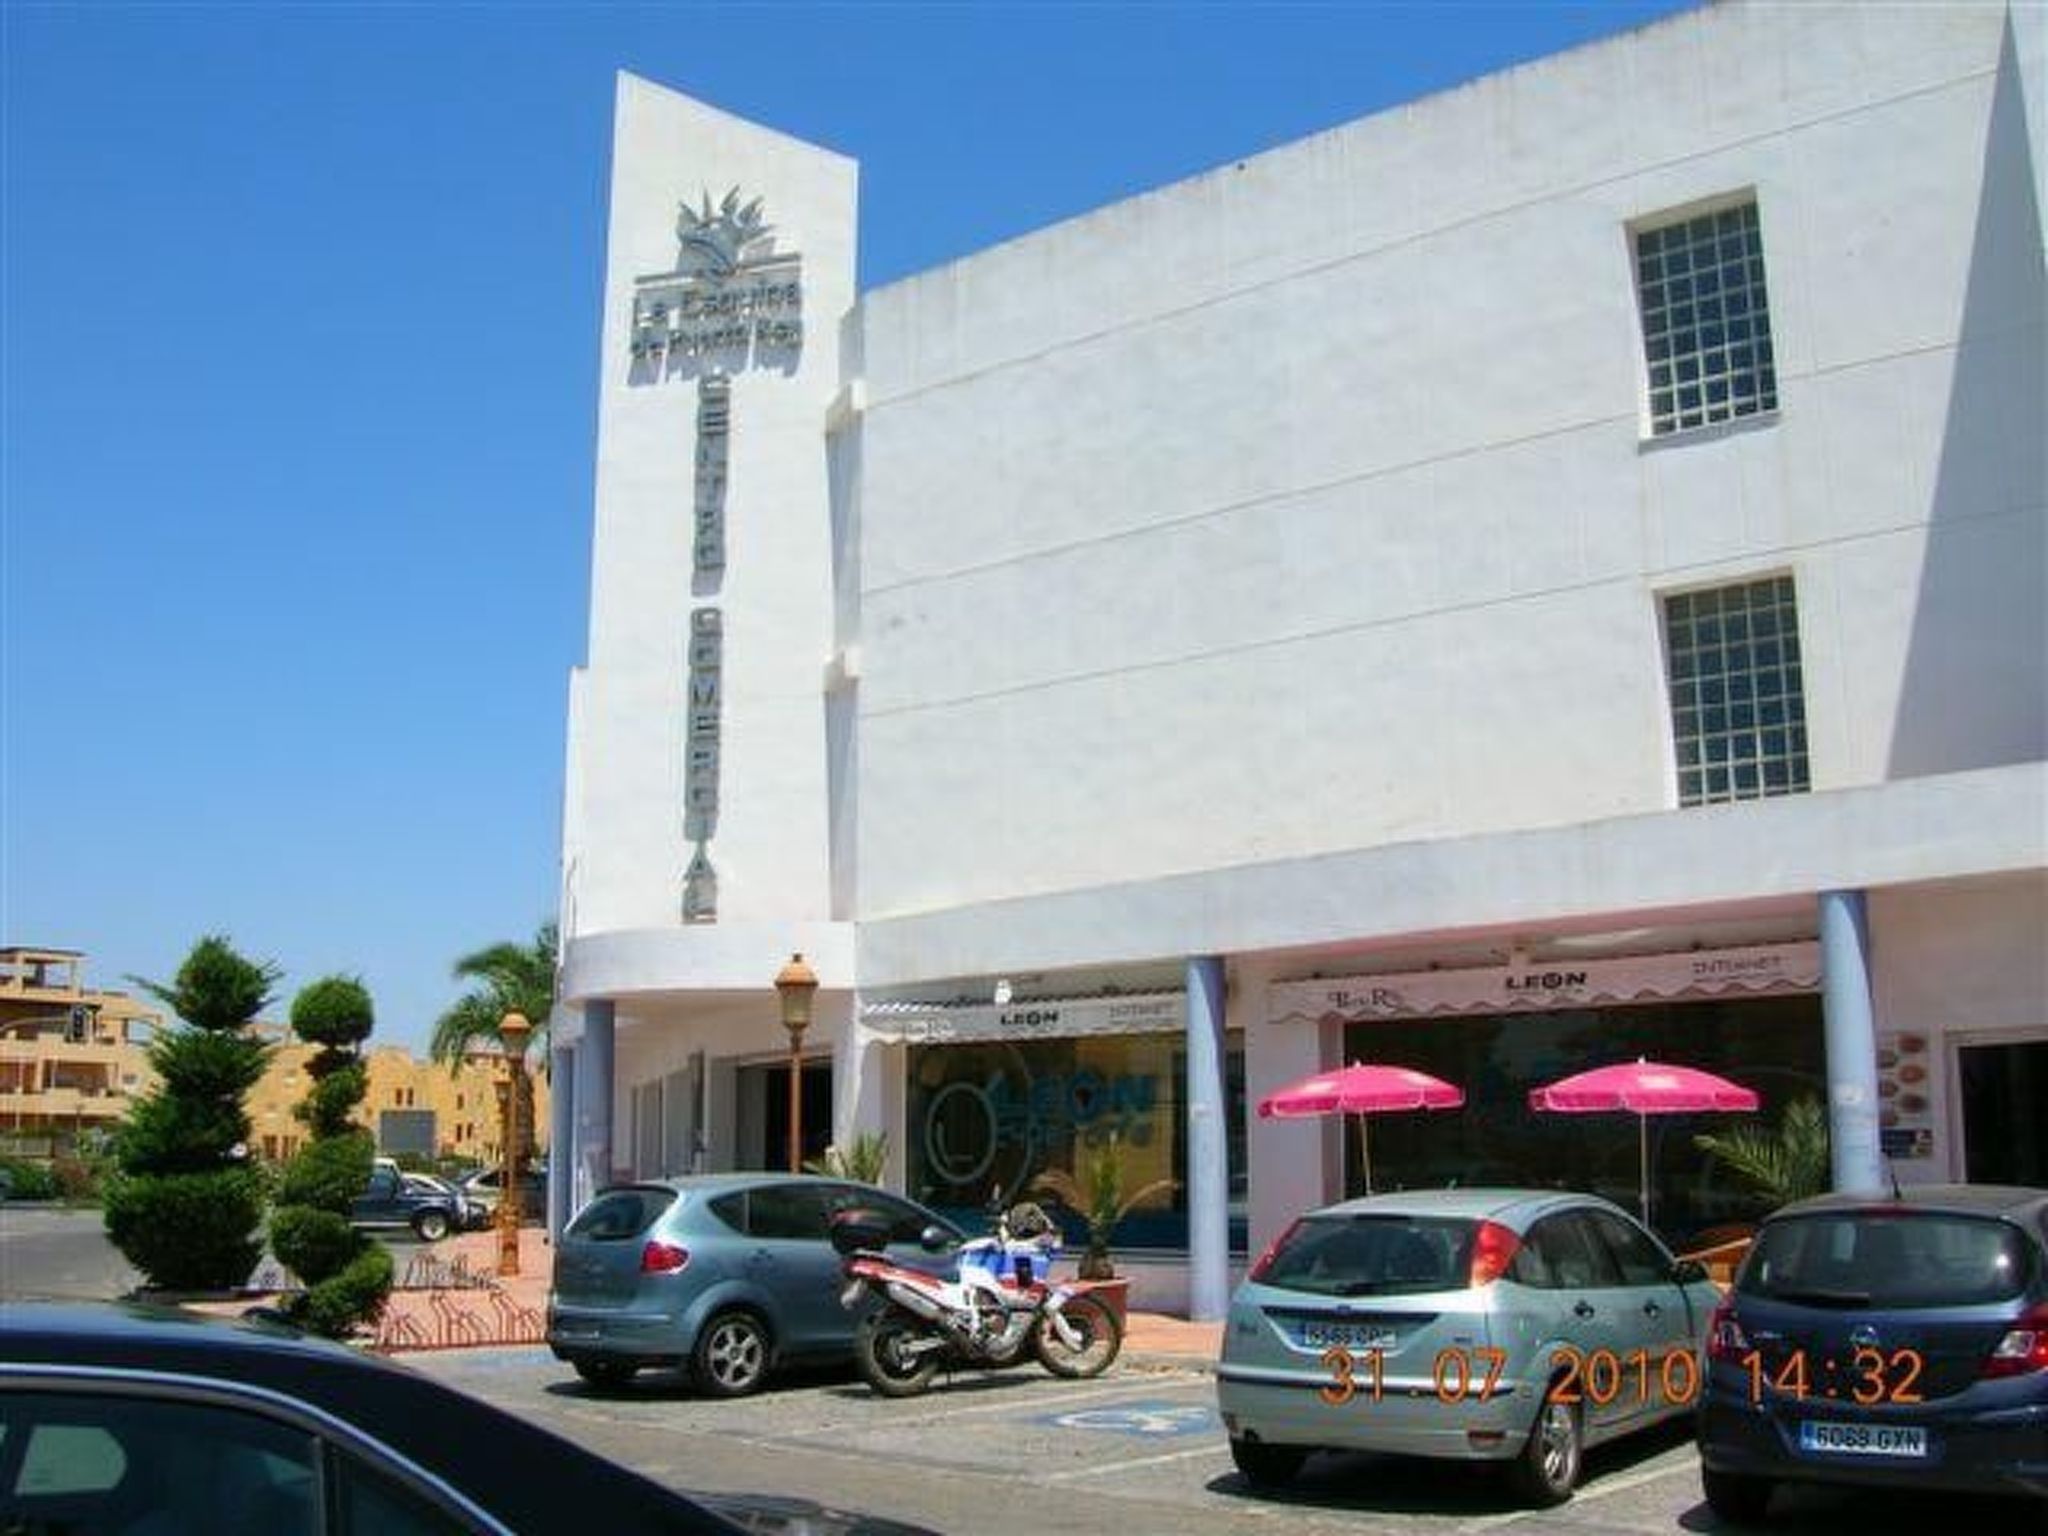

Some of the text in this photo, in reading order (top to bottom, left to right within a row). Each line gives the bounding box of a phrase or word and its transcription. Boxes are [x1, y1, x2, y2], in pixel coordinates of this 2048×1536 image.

[633, 297, 667, 326] La
[682, 606, 722, 924] COMERCIAL
[1505, 972, 1587, 990] LEON
[1000, 1011, 1059, 1026] LEON
